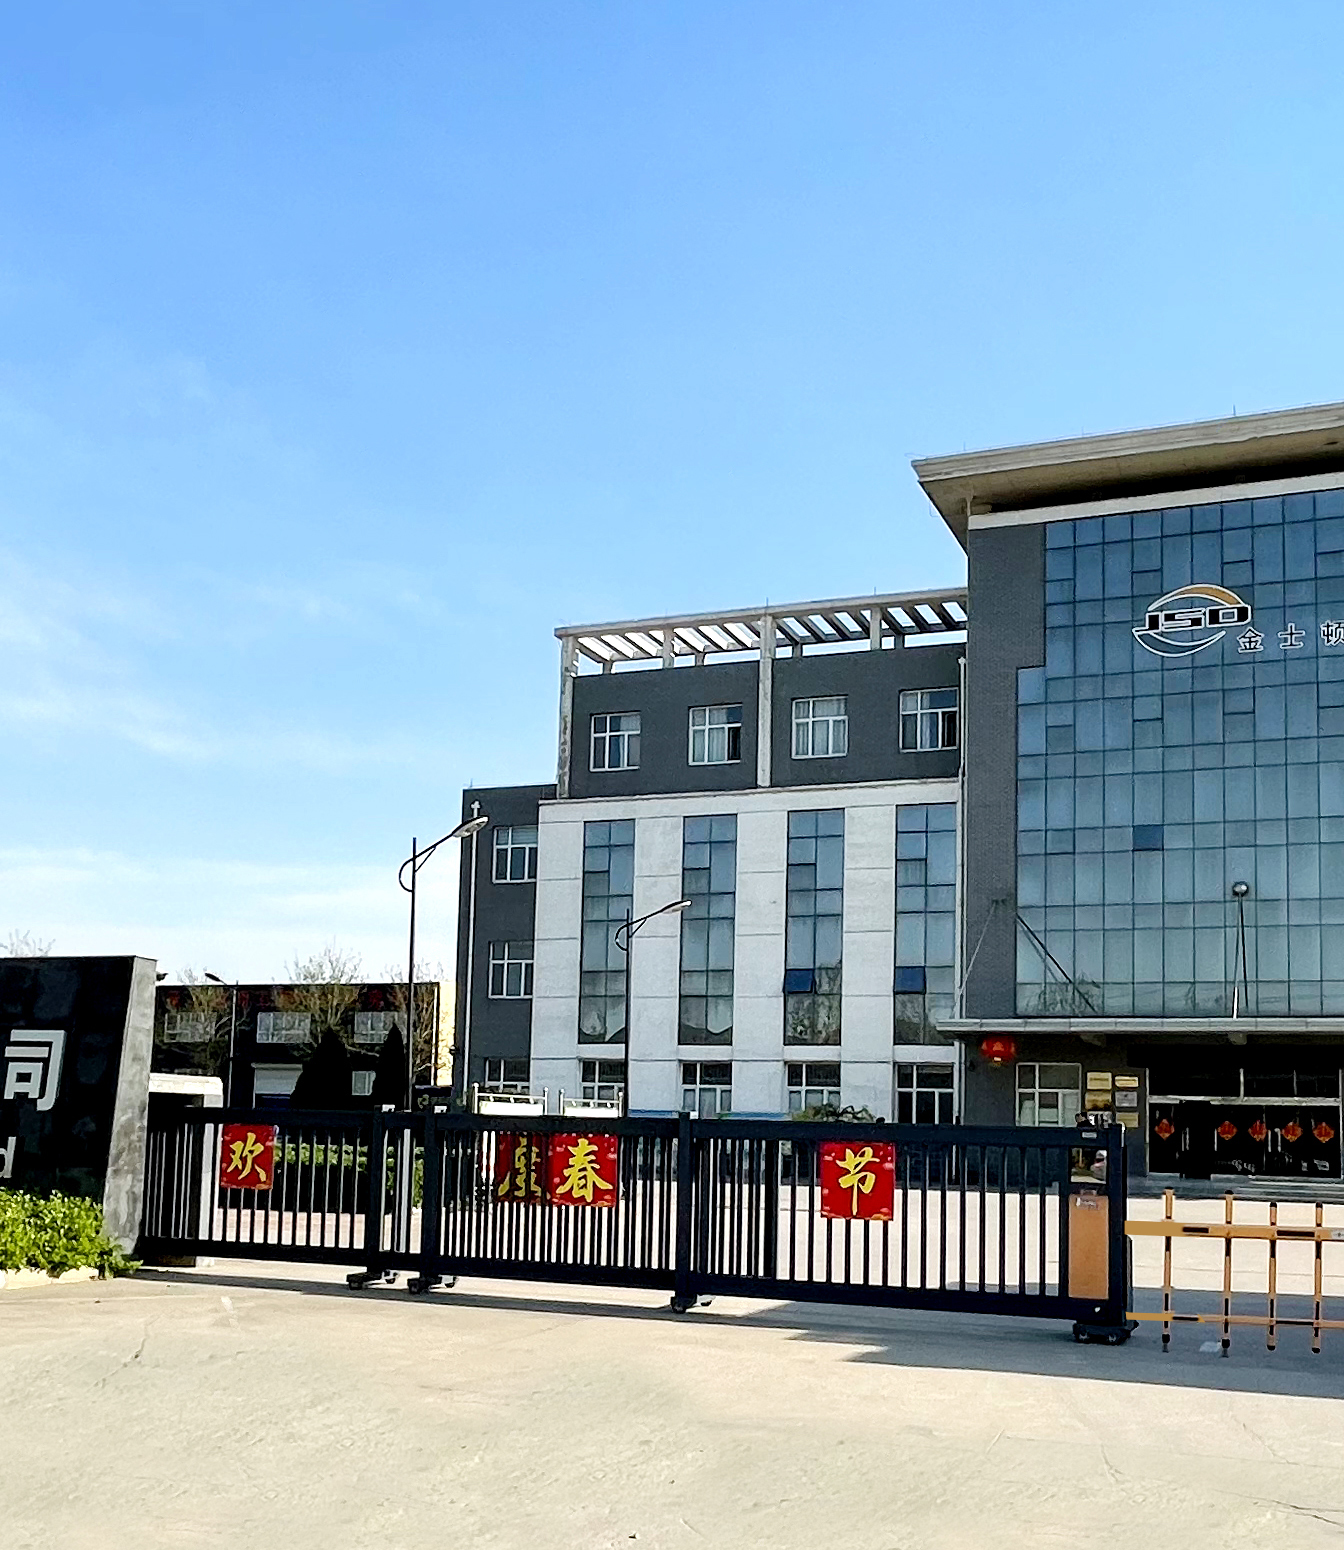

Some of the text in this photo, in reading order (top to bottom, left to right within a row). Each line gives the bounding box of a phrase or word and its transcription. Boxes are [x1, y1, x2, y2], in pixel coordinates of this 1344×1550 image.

[226, 1132, 268, 1180] 欢
[556, 1138, 613, 1202] 春
[835, 1148, 879, 1216] 节
